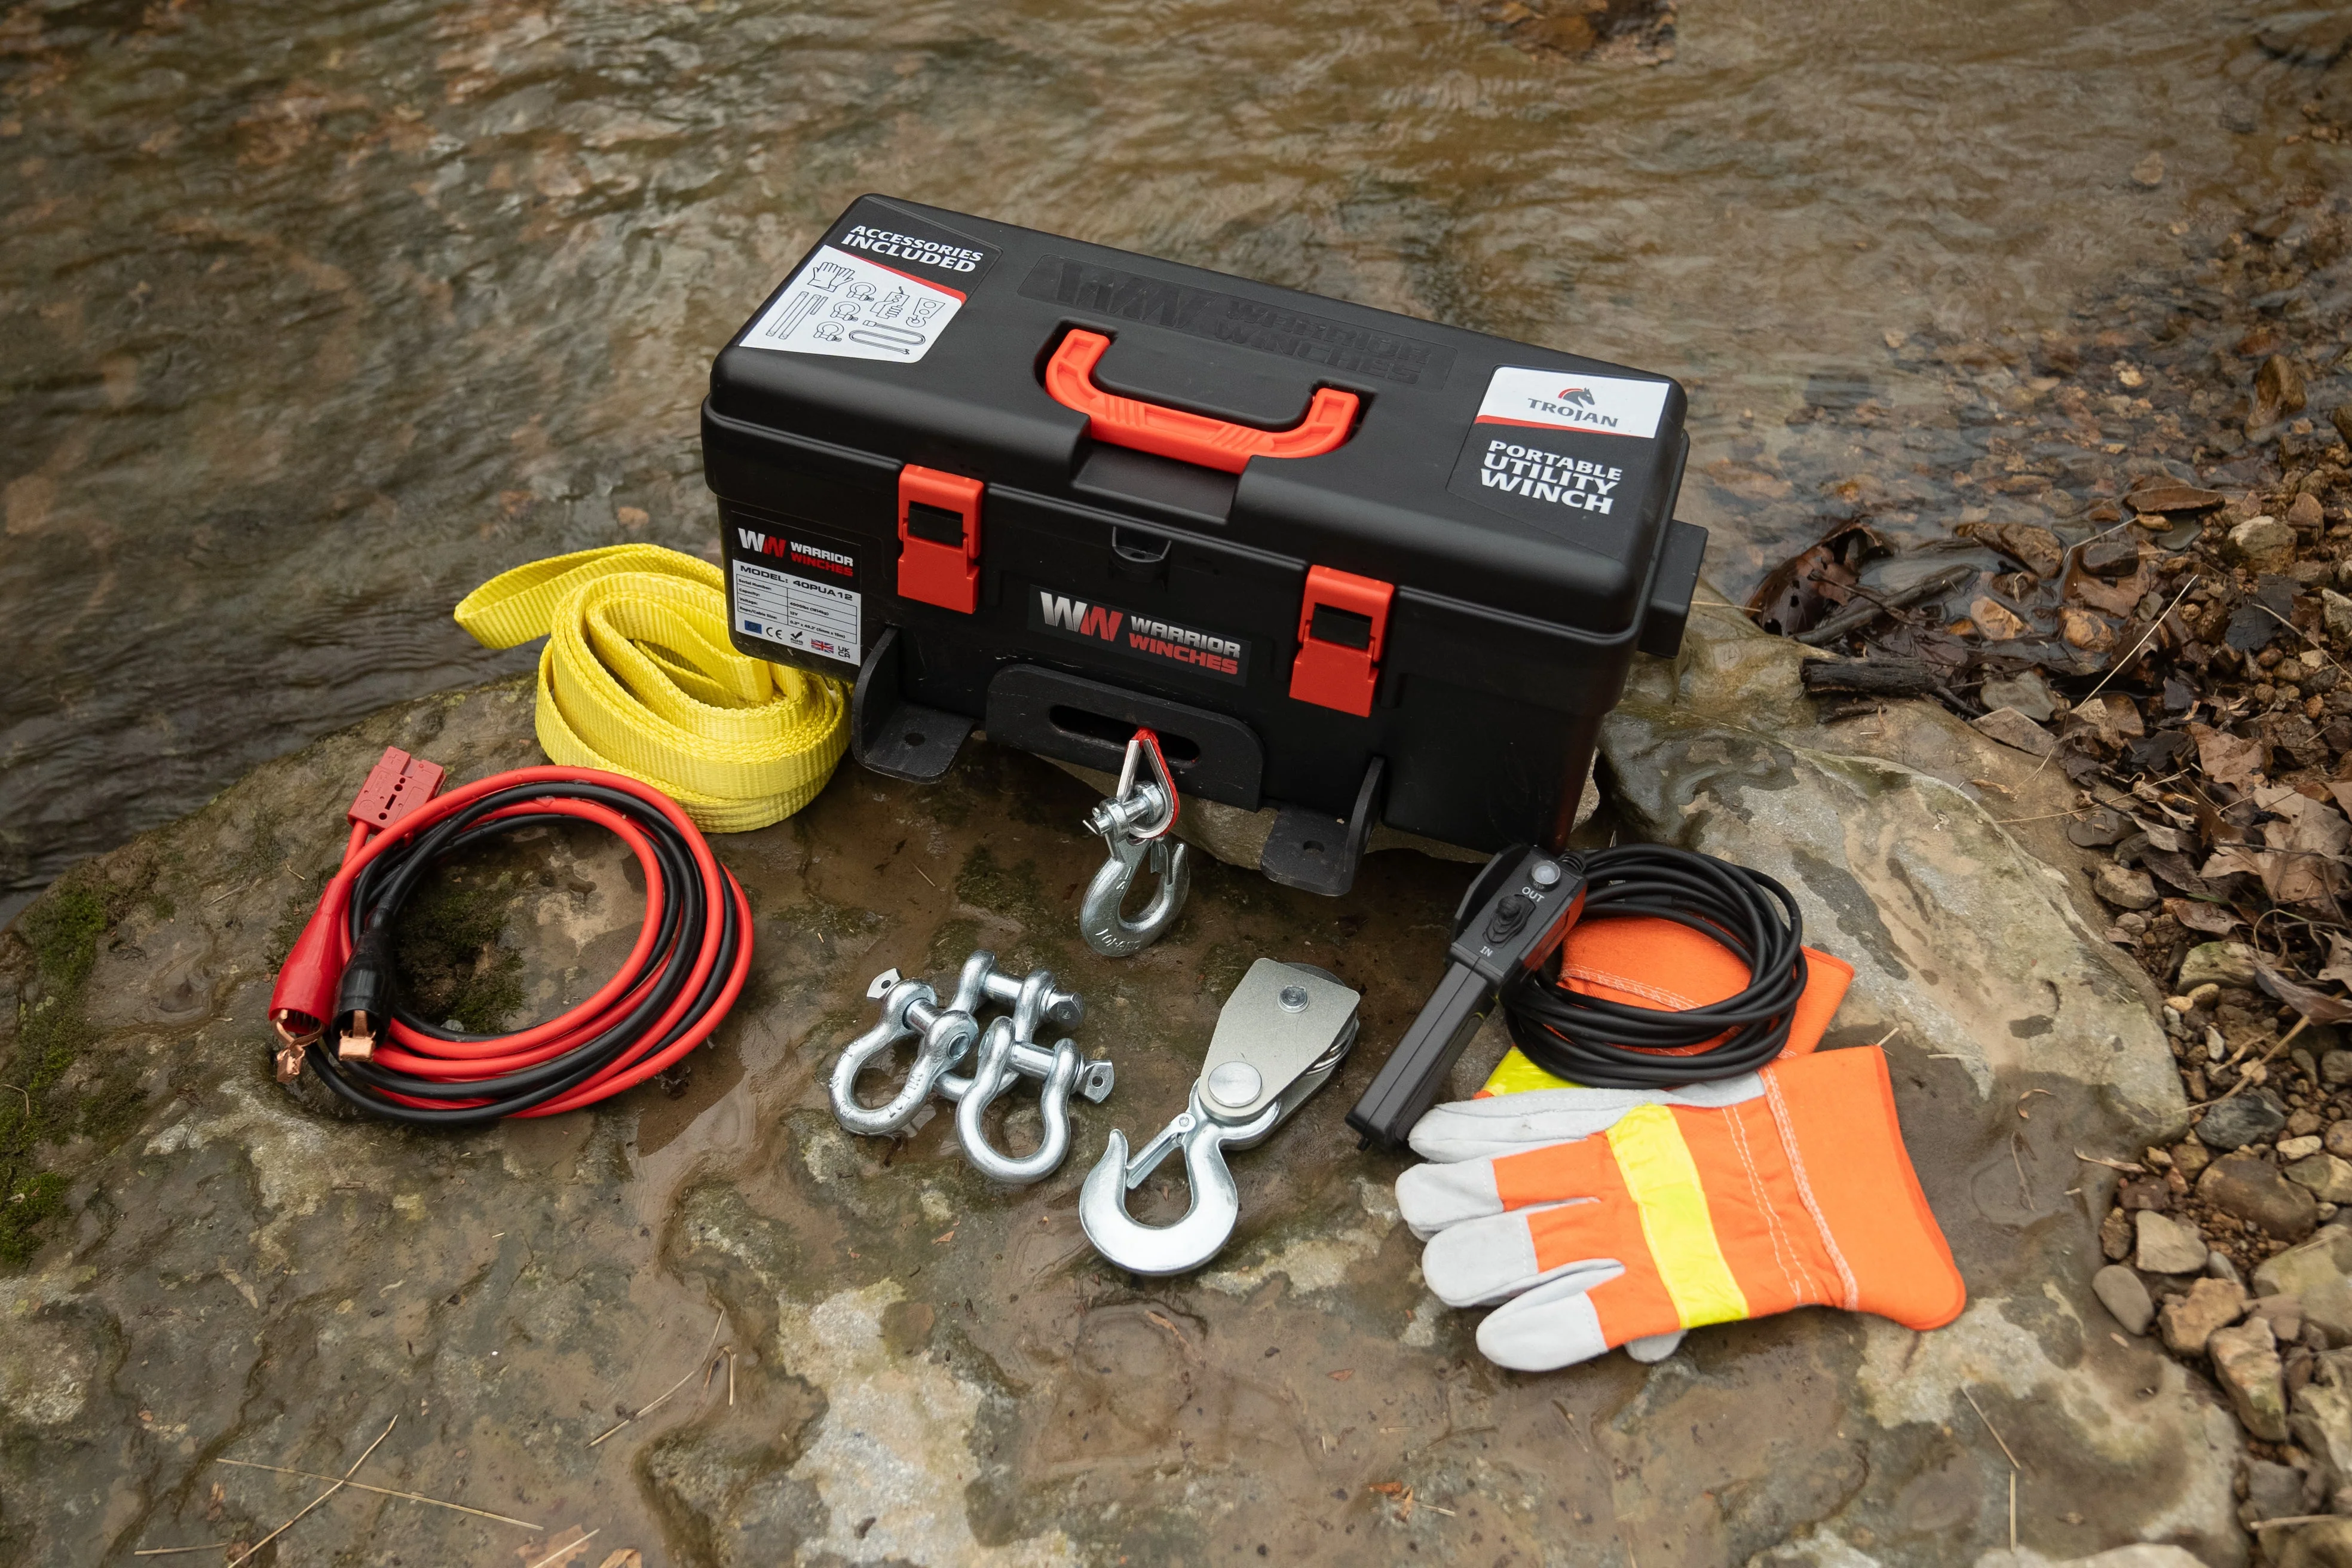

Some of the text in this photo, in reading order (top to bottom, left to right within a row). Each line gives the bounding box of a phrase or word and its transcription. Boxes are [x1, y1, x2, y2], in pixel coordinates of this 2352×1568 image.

[841, 234, 976, 272] INCLUDED
[850, 225, 984, 262] ACCESSORIES
[1528, 398, 1618, 428] TROJAN
[1484, 453, 1618, 495] UTILITY
[1488, 440, 1623, 481] PORTABLE
[1480, 468, 1614, 515] WINCH
[790, 541, 853, 566] WARRIOR
[791, 552, 853, 577] WINCHES
[739, 588, 760, 597] Capacity:
[740, 565, 853, 601] MODEL: 40PUA12
[739, 597, 758, 605] Voltage:
[765, 627, 783, 640] CE
[1131, 615, 1241, 658] WARRIOR
[838, 645, 850, 654] UK
[1129, 632, 1238, 675] WINCHES
[1522, 887, 1545, 903] OUT
[1480, 945, 1493, 957] IN
